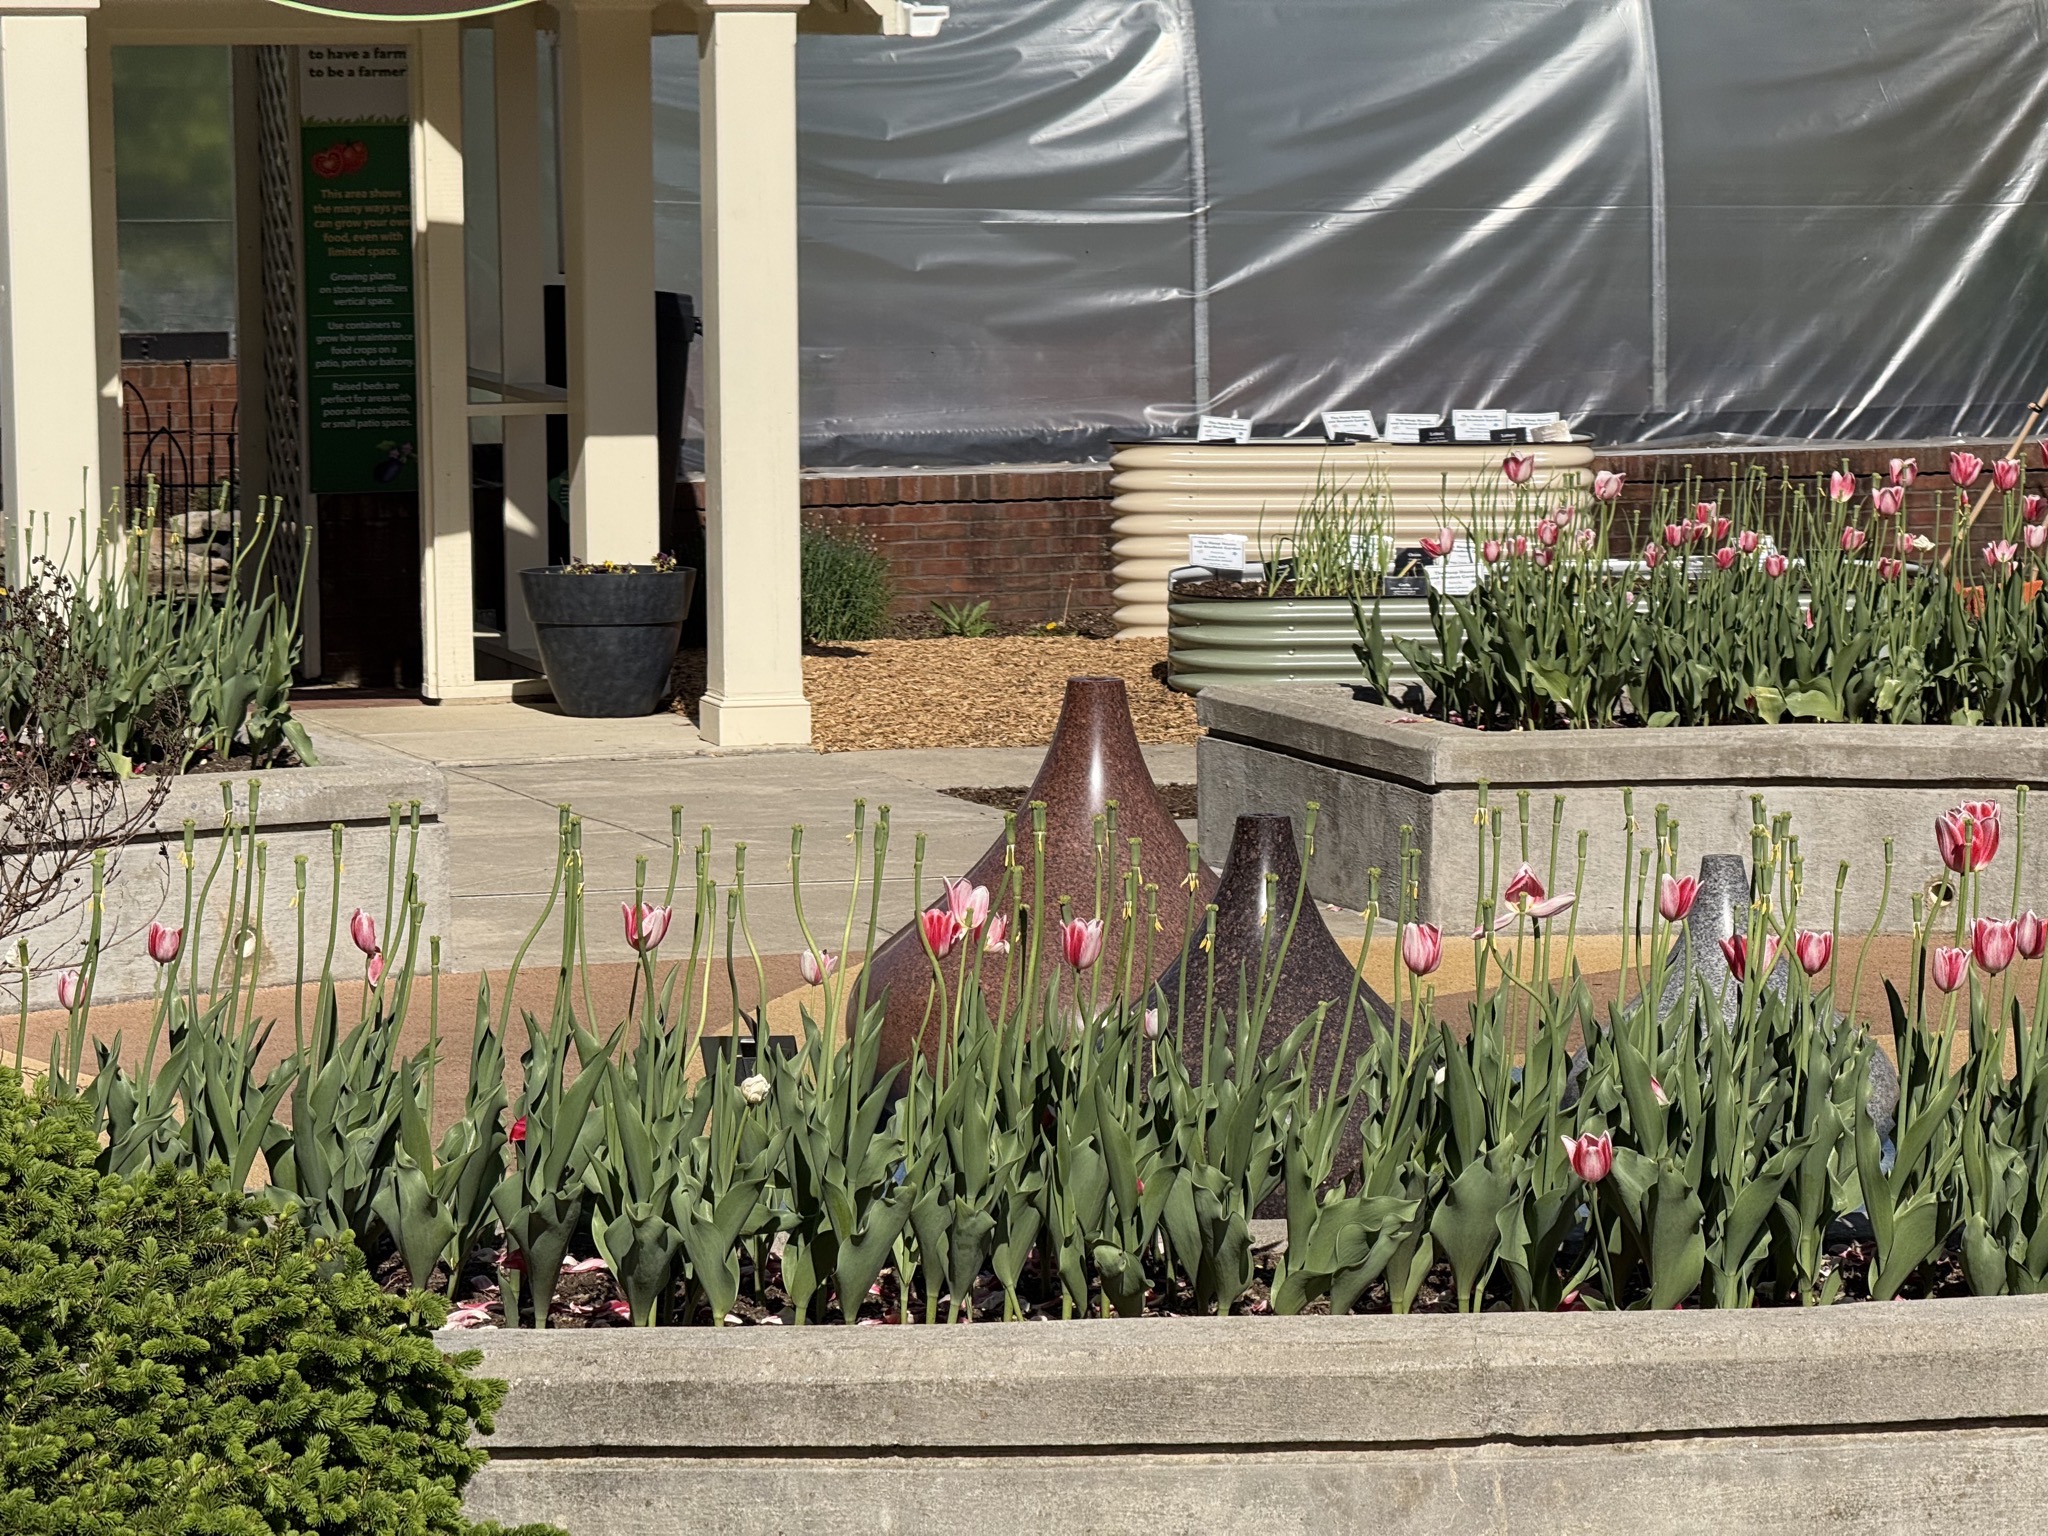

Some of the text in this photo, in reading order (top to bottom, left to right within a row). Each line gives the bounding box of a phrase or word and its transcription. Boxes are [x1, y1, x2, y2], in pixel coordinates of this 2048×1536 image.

[308, 47, 407, 59] to have a farm
[309, 67, 324, 77] to
[327, 66, 344, 77] be
[347, 69, 355, 77] a
[320, 188, 402, 199] This area shows
[313, 204, 331, 213] the
[334, 205, 361, 215] many
[364, 205, 390, 215] ways
[313, 220, 333, 229] can
[334, 220, 362, 230] grow
[363, 219, 388, 229] your
[323, 231, 403, 242] food, even with
[328, 247, 400, 258] limited space.
[330, 271, 396, 282] Growing plants
[333, 285, 376, 294] structures
[333, 297, 395, 307] vertical space.
[327, 321, 401, 330] Use containers to
[315, 333, 414, 345] grow low maintenance
[330, 346, 397, 356] food crops on a
[315, 359, 341, 369] patio,
[341, 358, 367, 369] porch
[332, 382, 361, 391] Raised
[362, 381, 385, 390] beds
[320, 393, 412, 406] perfect for areas with
[322, 408, 345, 418] poor
[346, 406, 361, 416] soil
[320, 418, 413, 430] or small patio spaces.
